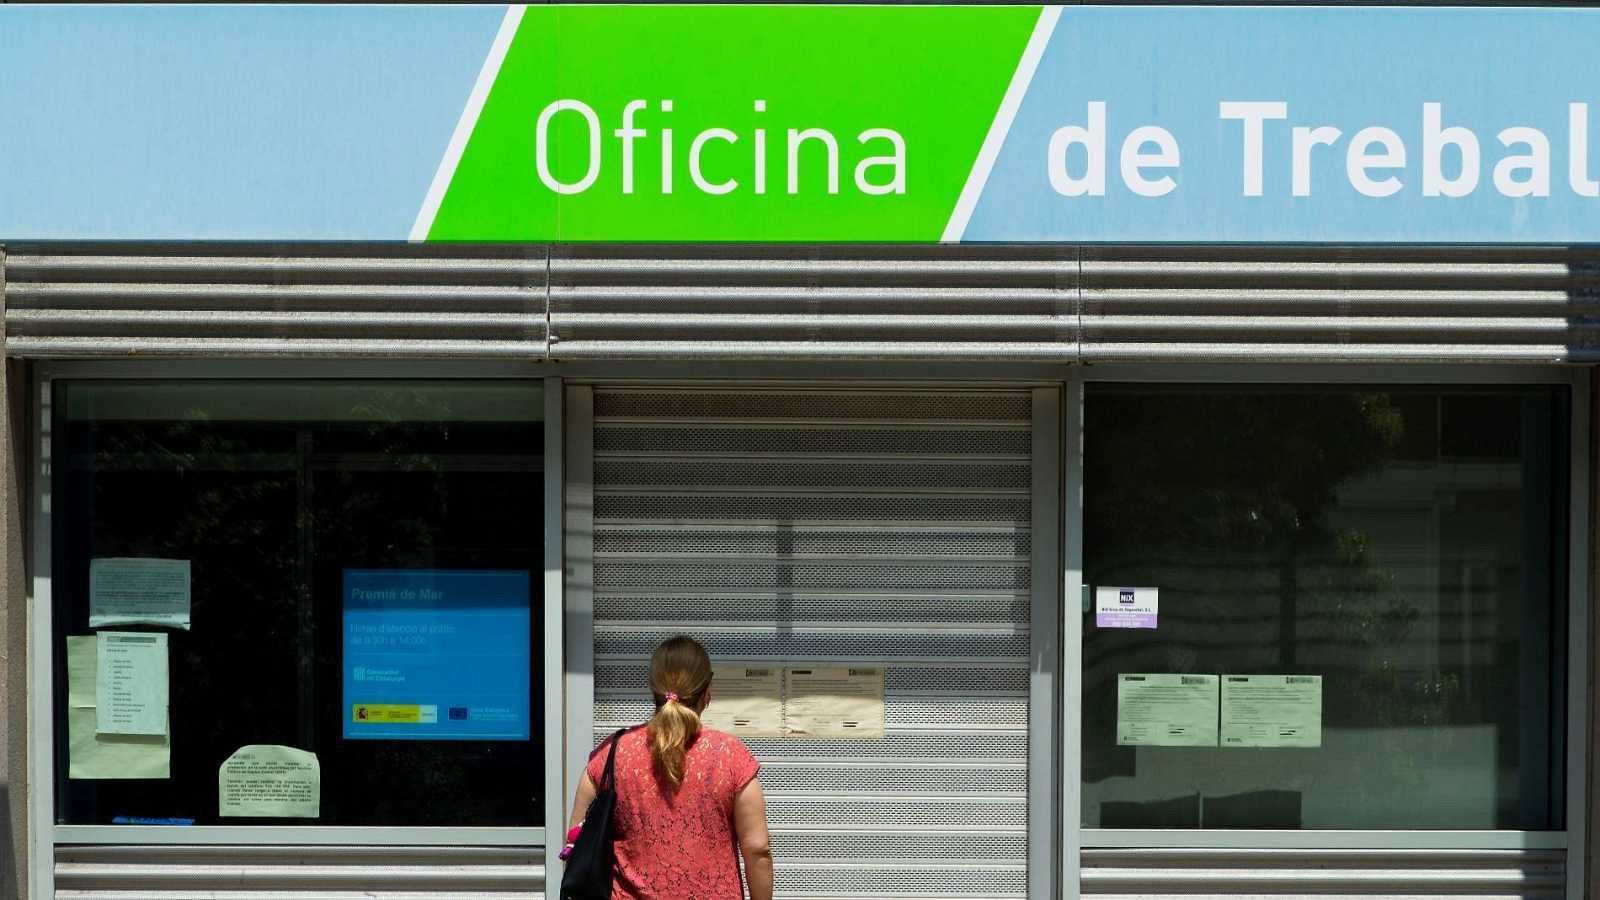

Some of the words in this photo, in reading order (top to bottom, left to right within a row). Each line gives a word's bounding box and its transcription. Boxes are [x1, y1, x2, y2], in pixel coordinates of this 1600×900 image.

[537, 100, 905, 194] Oficina
[1048, 101, 1180, 197] de
[1219, 101, 1600, 197] Trebal
[400, 587, 417, 601] de
[419, 587, 443, 601] Mar
